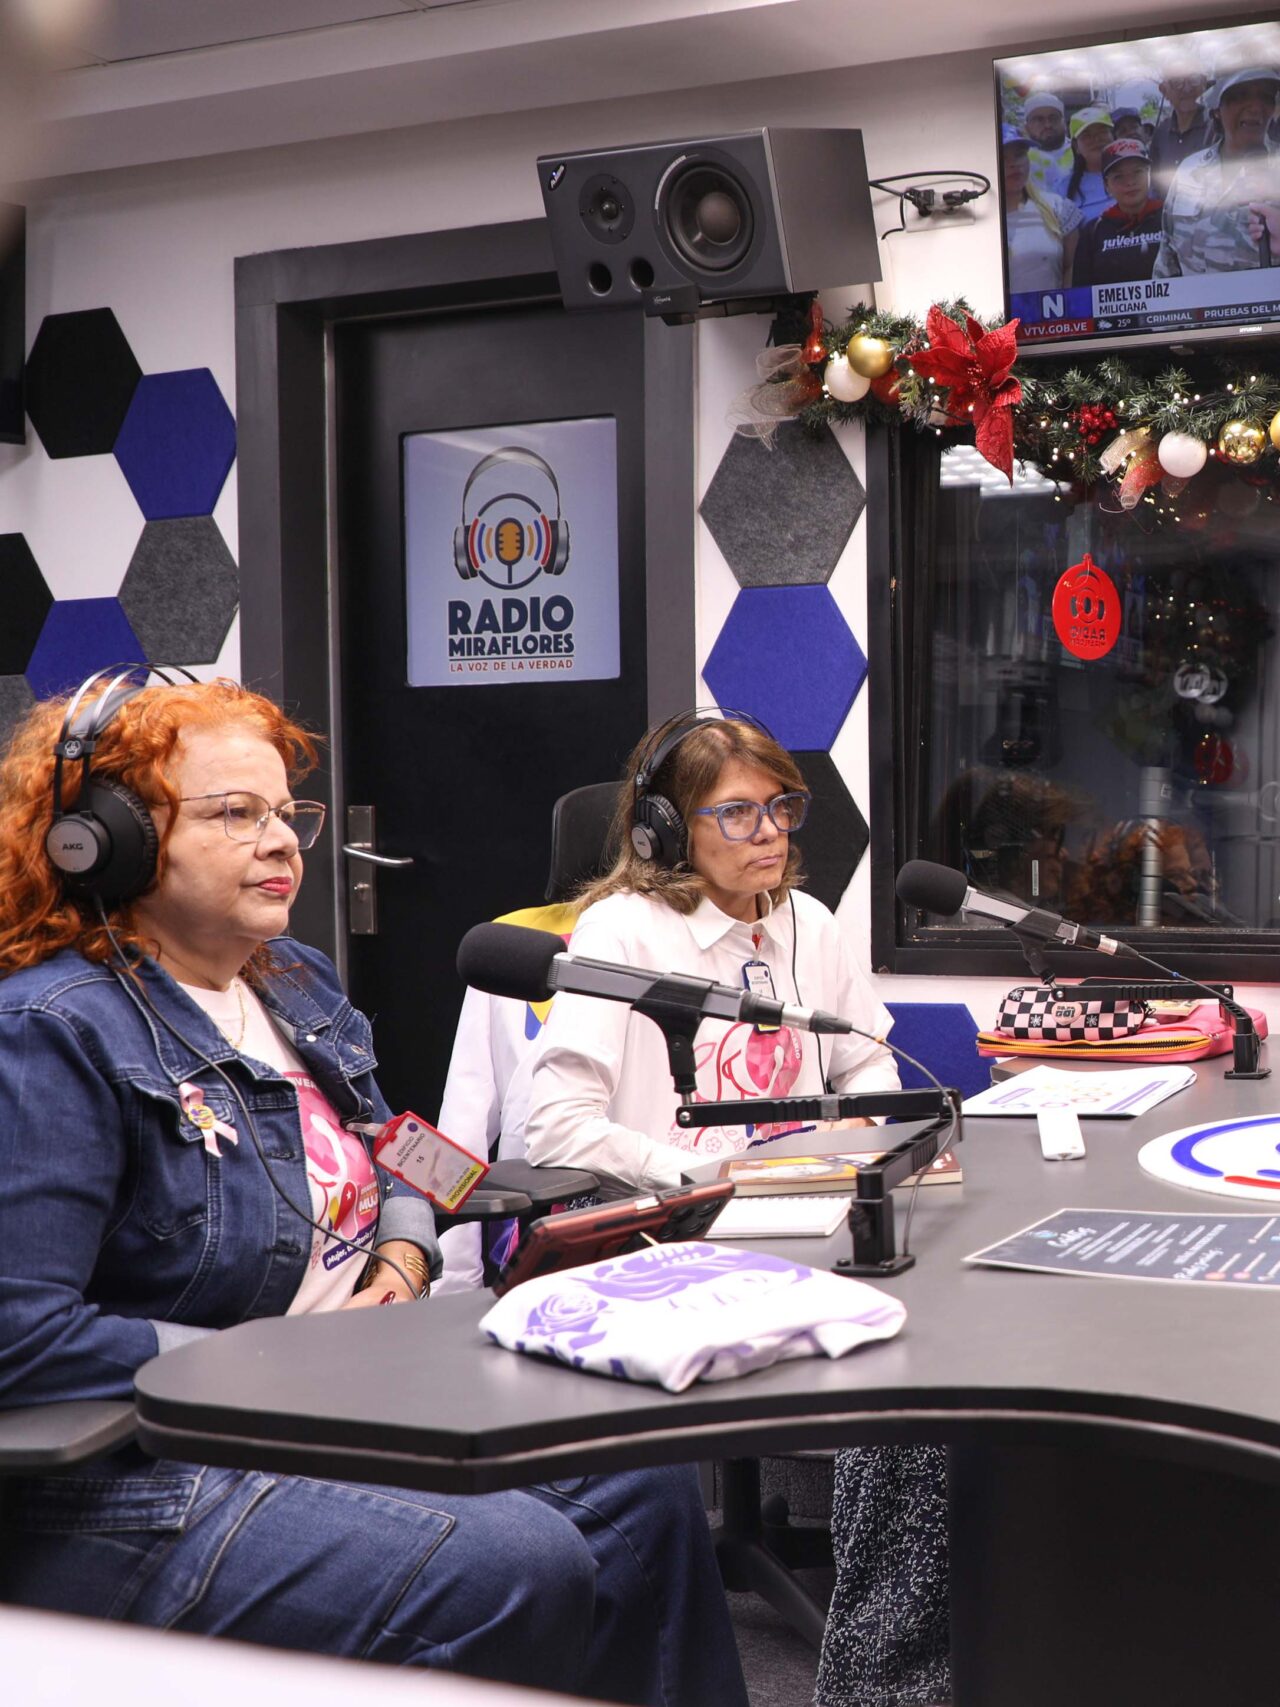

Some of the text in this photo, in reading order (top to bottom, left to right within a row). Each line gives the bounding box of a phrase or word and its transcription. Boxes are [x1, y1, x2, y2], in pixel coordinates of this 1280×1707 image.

[1098, 281, 1170, 303] EMELYS DÍAZ
[1042, 294, 1064, 319] N
[1099, 302, 1148, 315] MILICIANA
[1146, 312, 1193, 324] CRIMINAL
[1204, 306, 1249, 318] PRUEBAS
[1251, 304, 1271, 315] DEL
[1024, 321, 1088, 336] VTV.GOB.VE
[448, 594, 575, 636] RADIO
[448, 633, 575, 658] MIRAFLORES
[450, 659, 573, 672] LA VOZ DE LA VERDAD
[397, 1133, 425, 1168] BICENTENARIO
[450, 1170, 478, 1202] PROVISIONAL
